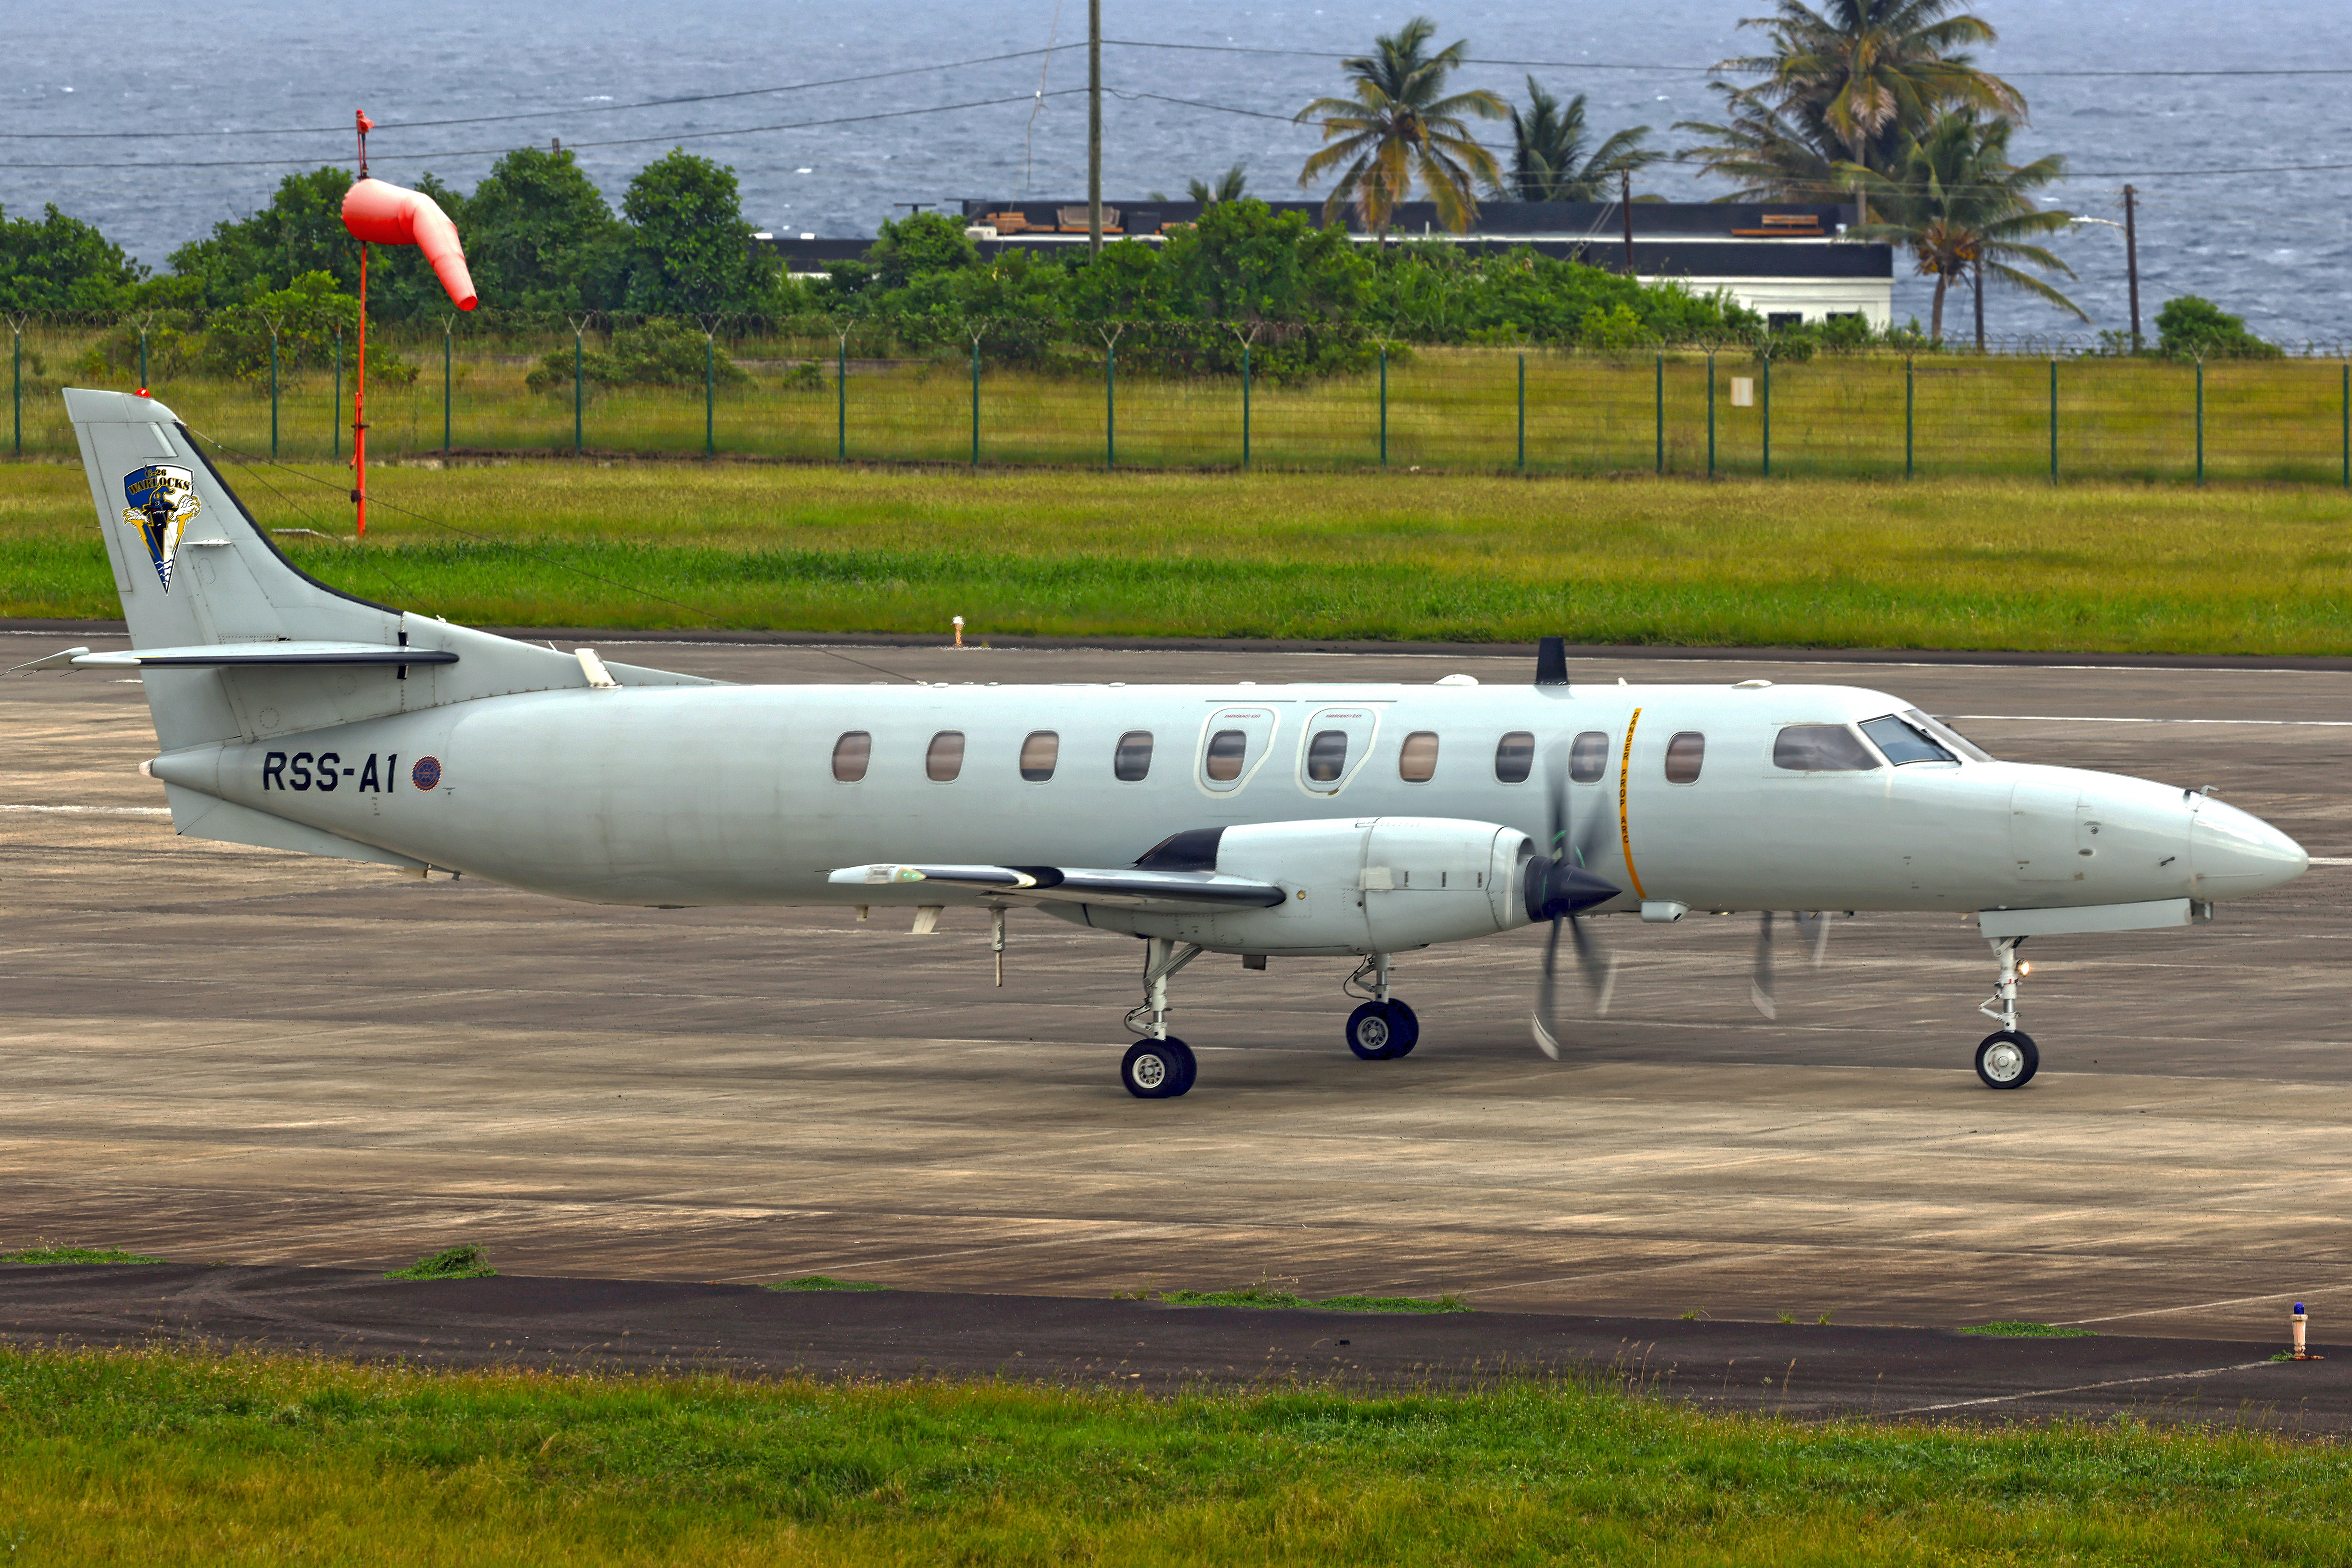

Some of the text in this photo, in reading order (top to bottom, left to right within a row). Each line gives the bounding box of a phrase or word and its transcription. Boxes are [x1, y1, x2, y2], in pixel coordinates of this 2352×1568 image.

[128, 477, 190, 495] WARLOCKS
[145, 469, 167, 478] C-26
[1623, 712, 1639, 761] DANGER
[263, 751, 398, 793] RSS-A1
[1621, 815, 1629, 844] ARC
